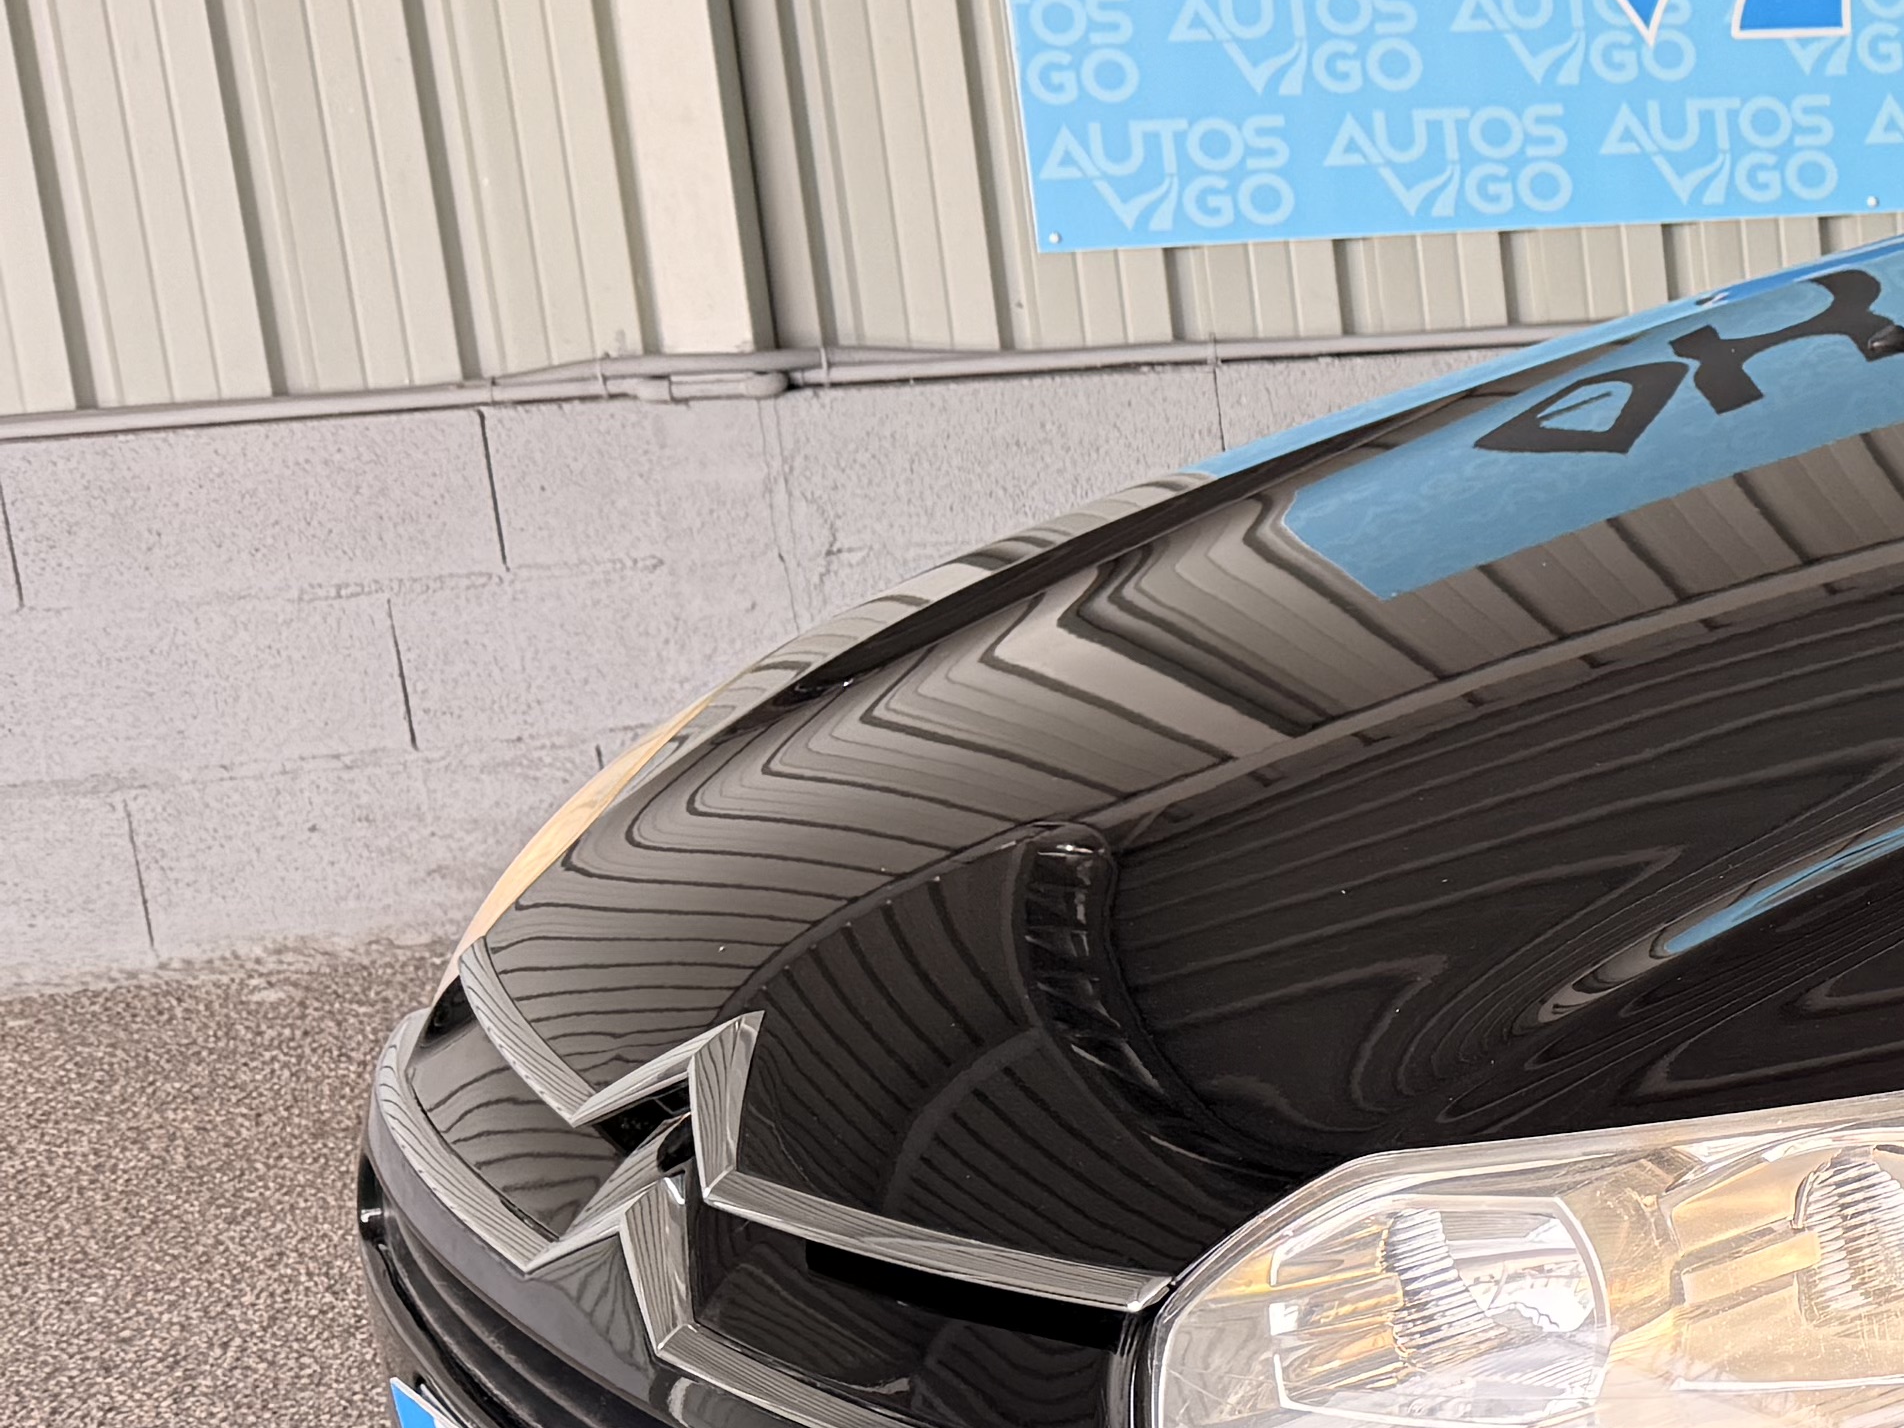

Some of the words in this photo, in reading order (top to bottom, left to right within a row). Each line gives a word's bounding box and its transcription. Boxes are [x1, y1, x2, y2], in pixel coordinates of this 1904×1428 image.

[1223, 37, 1422, 95] VIGO
[1503, 28, 1695, 84] VIGO
[1039, 114, 1289, 180] AUTOS
[1326, 103, 1567, 168] AUTOS
[1601, 93, 1833, 157] AUTOS
[1093, 172, 1295, 231] VIGO
[1378, 160, 1572, 217] VIGO
[1651, 149, 1837, 205] VIGO
